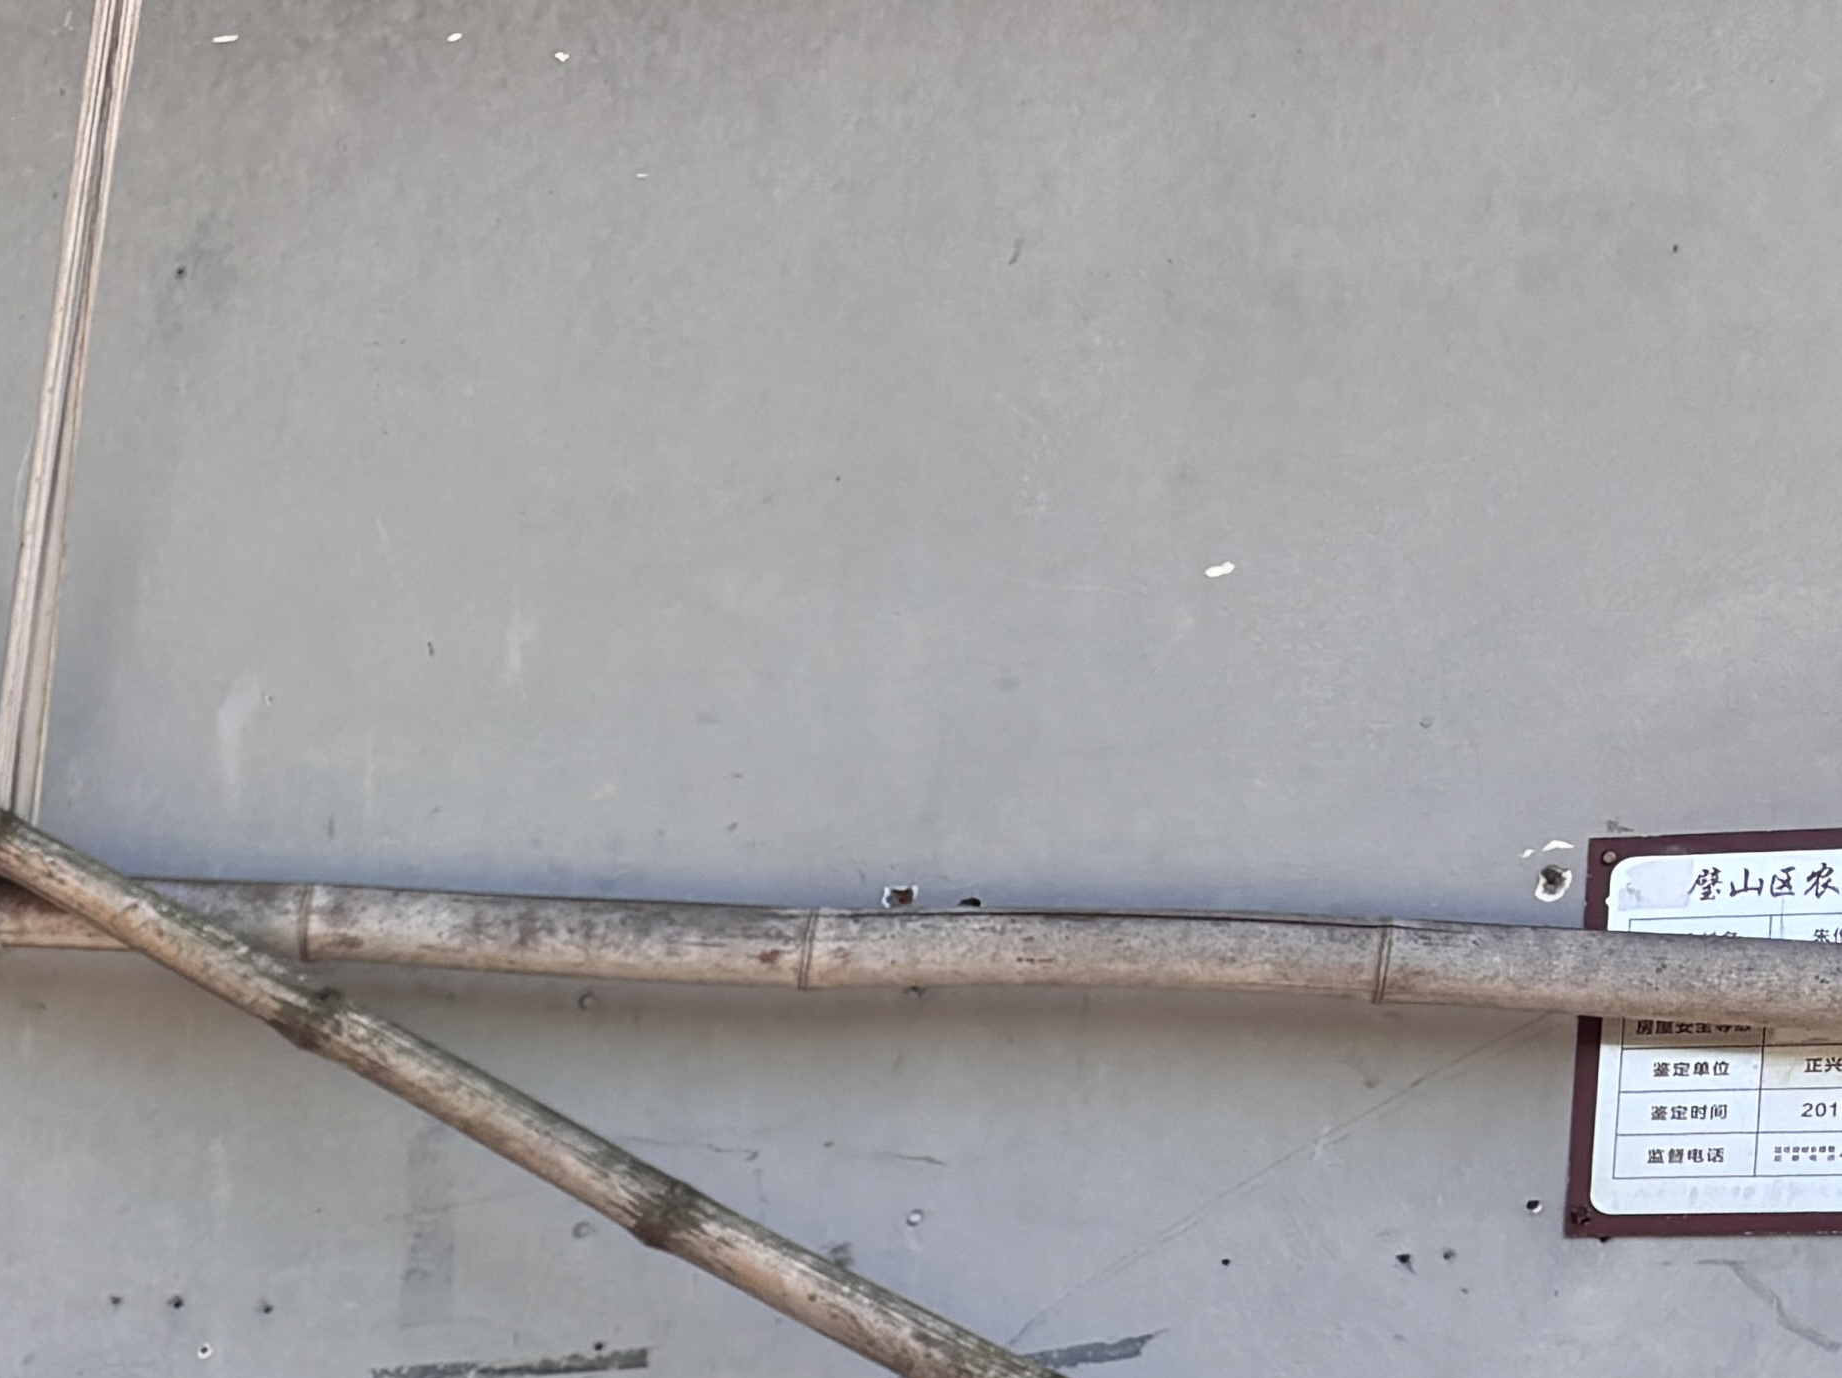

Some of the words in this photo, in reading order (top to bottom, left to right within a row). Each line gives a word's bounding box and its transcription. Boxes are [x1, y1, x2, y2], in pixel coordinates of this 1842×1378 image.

[1687, 862, 1840, 901] 璧山区农
[1653, 1061, 1730, 1078] 鉴定单位
[1650, 1104, 1728, 1121] 鉴定时间
[1800, 1101, 1838, 1118] 201
[1646, 1147, 1725, 1165] 监督电话
